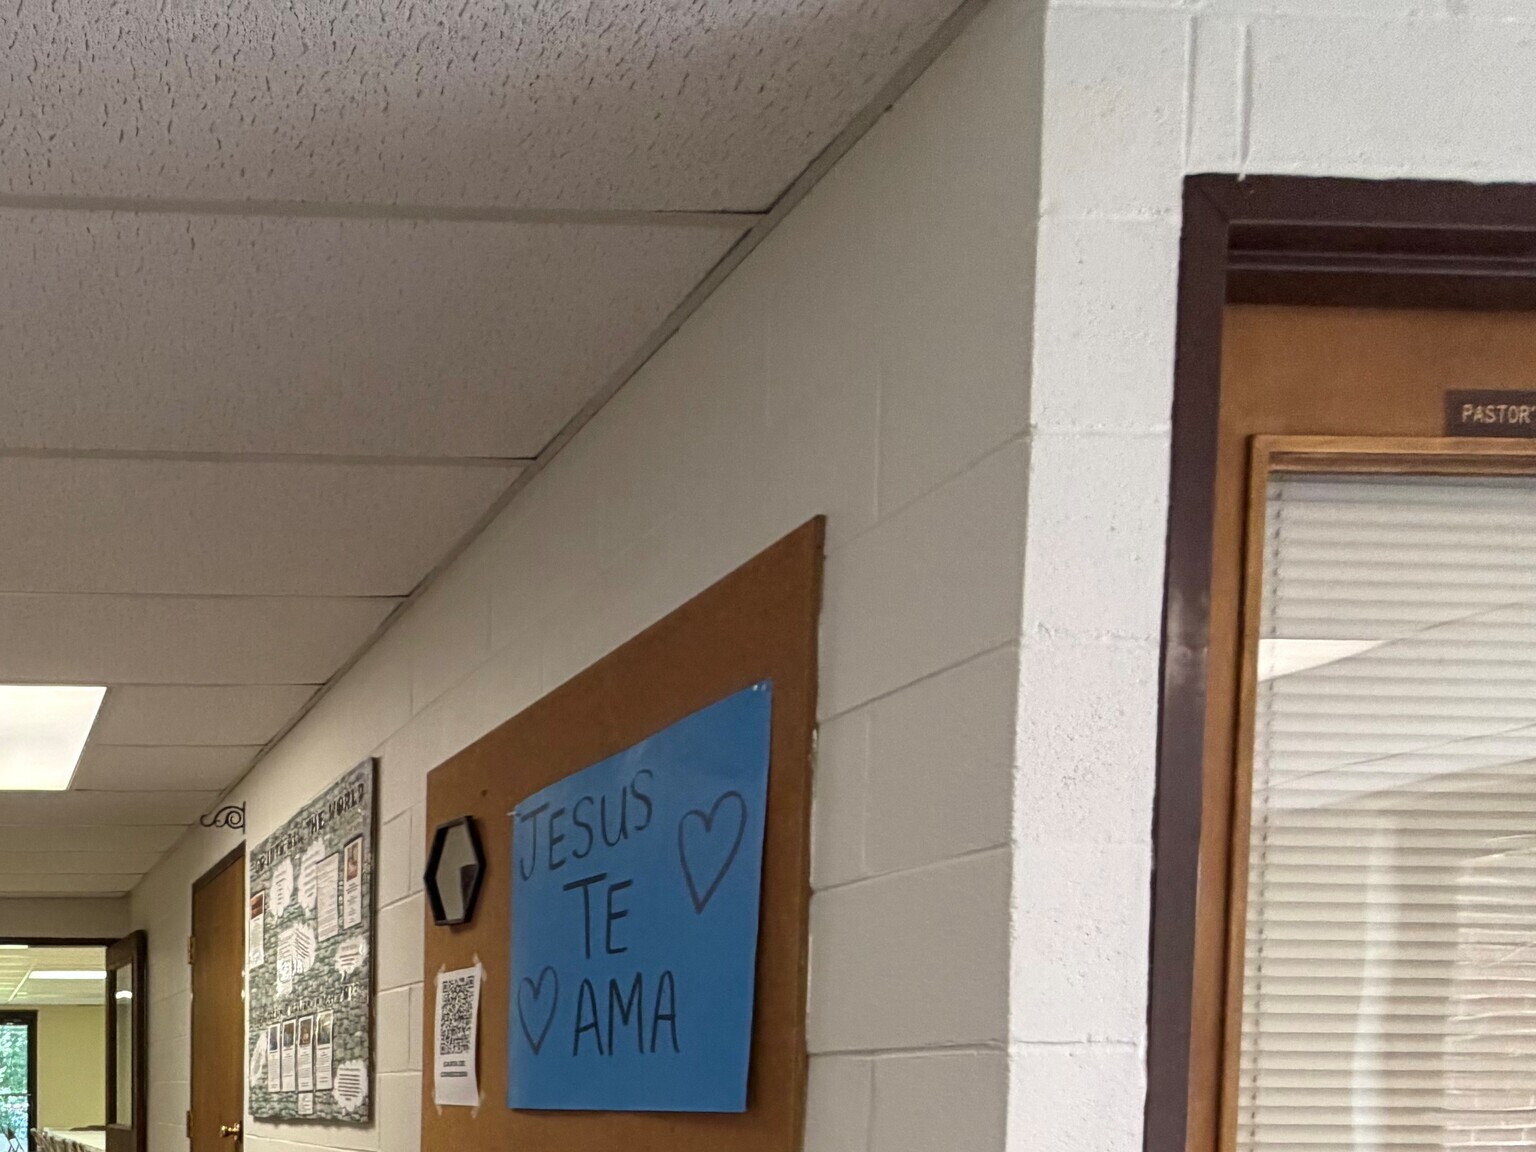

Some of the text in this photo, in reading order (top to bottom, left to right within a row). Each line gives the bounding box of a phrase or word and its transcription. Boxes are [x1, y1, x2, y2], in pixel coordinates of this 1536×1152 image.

[306, 809, 325, 835] THE
[328, 782, 364, 822] WORLD
[519, 769, 654, 882] JESUS
[562, 872, 633, 960] TE
[572, 969, 680, 1057] AMA
